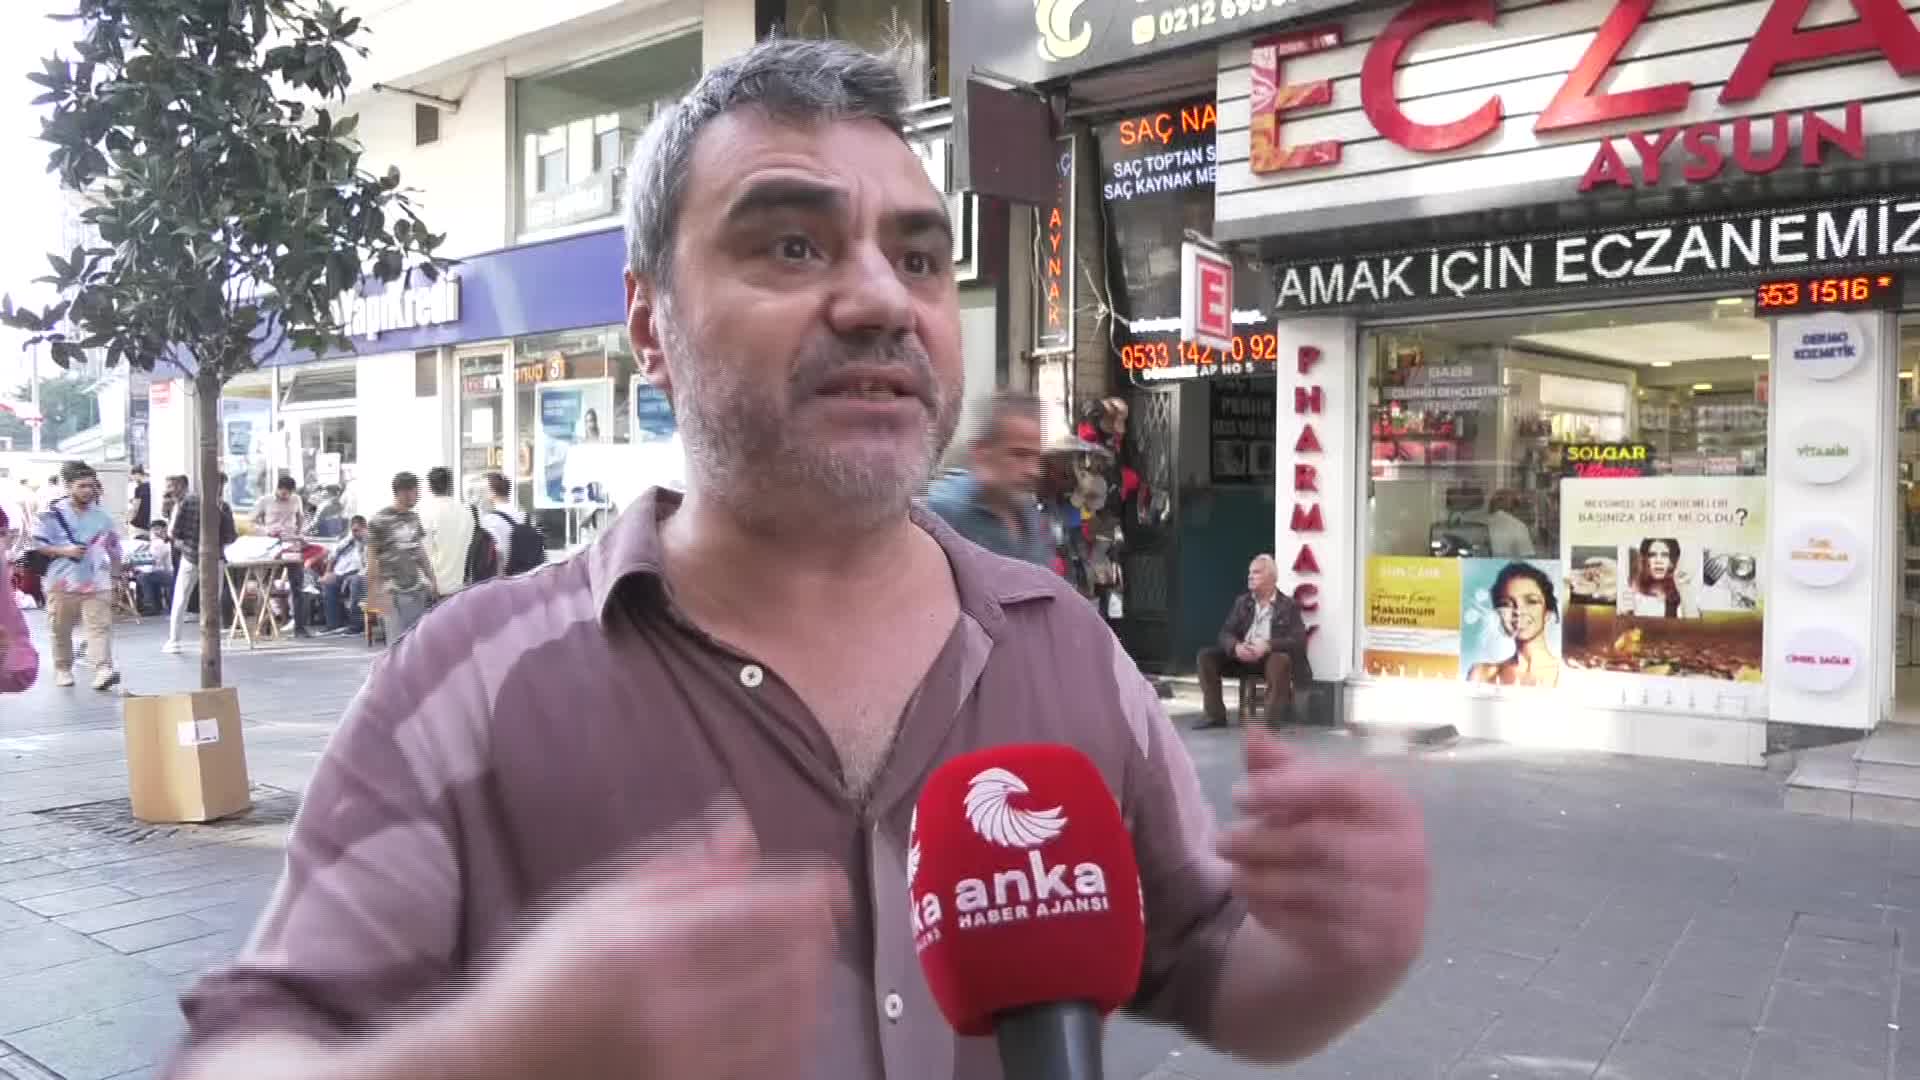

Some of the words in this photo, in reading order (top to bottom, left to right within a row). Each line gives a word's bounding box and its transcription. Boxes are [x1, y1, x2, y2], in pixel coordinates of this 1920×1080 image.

[1159, 3, 1217, 35] 0212
[1119, 113, 1173, 145] SAÇ
[1182, 103, 1217, 134] NA
[1113, 160, 1142, 179] SAÇ
[1143, 147, 1203, 173] TOPTAN
[1578, 100, 1864, 192] AYSUN
[1103, 181, 1133, 200] SAÇ
[1135, 170, 1192, 194] KAYNAK
[1275, 254, 1415, 308] AMAK
[1429, 241, 1533, 299] İÇİN
[1555, 199, 1920, 284] ECZANEMİZ
[1201, 268, 1225, 330] E
[1808, 276, 1870, 304] 1516
[1121, 342, 1169, 370] 0533
[1177, 339, 1223, 368] 142
[1250, 333, 1276, 361] 92
[1568, 445, 1648, 461] SOLGAR
[1370, 604, 1436, 617] Maksimum
[956, 849, 1107, 912] anka
[958, 904, 1030, 929] HABER
[1036, 895, 1109, 918] AJANSI
